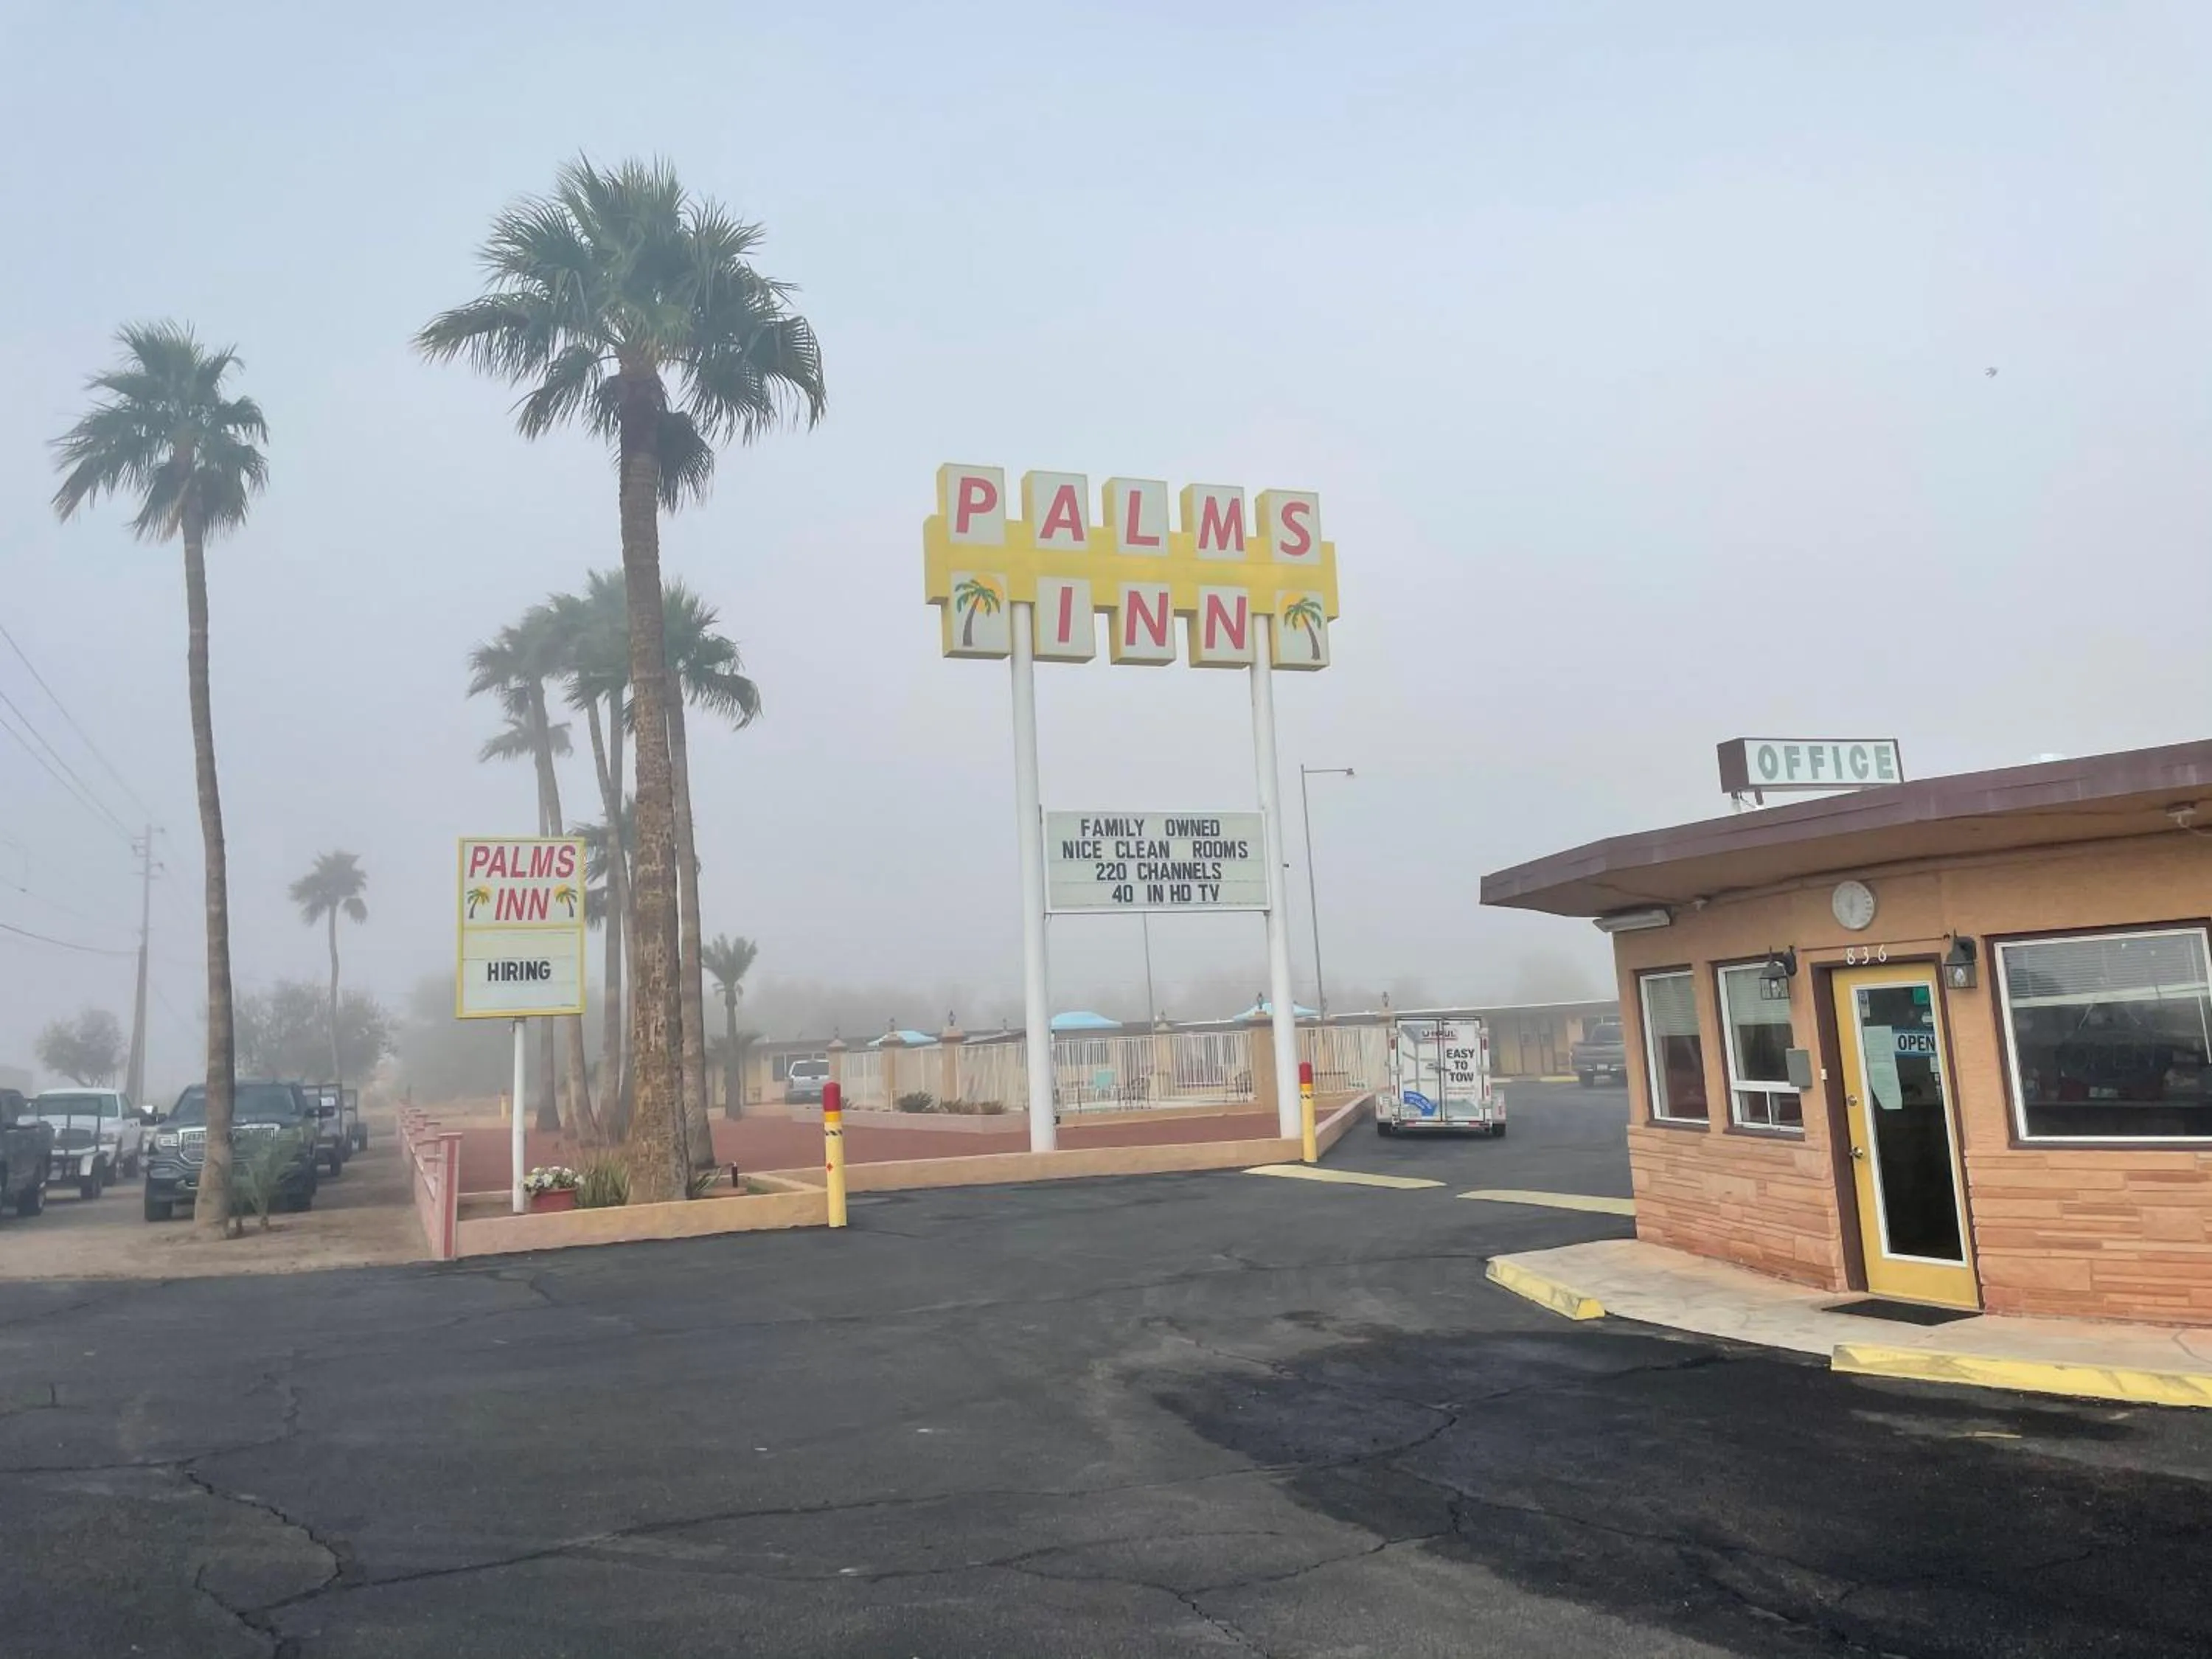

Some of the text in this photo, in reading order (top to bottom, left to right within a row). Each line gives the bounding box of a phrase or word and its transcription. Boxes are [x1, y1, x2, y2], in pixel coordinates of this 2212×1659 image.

[955, 476, 1312, 557] PALMS
[1057, 585, 1248, 650] INN
[1757, 744, 1894, 781] OFFICE
[1080, 818, 1221, 838] FAMILY OWNED
[1062, 840, 1249, 860] NICE CLEAN ROOMS
[468, 844, 576, 878] PALMS
[1096, 862, 1222, 881] 220 CHANNELS
[1111, 884, 1220, 903] 40 IN HD TV
[495, 888, 551, 921] INN
[1846, 945, 1888, 965] 836
[487, 961, 552, 982] HIRING
[1897, 1034, 1936, 1051] OPEN
[1446, 1048, 1475, 1059] EASY
[1454, 1060, 1469, 1071] TO
[1450, 1072, 1475, 1082] TOW
